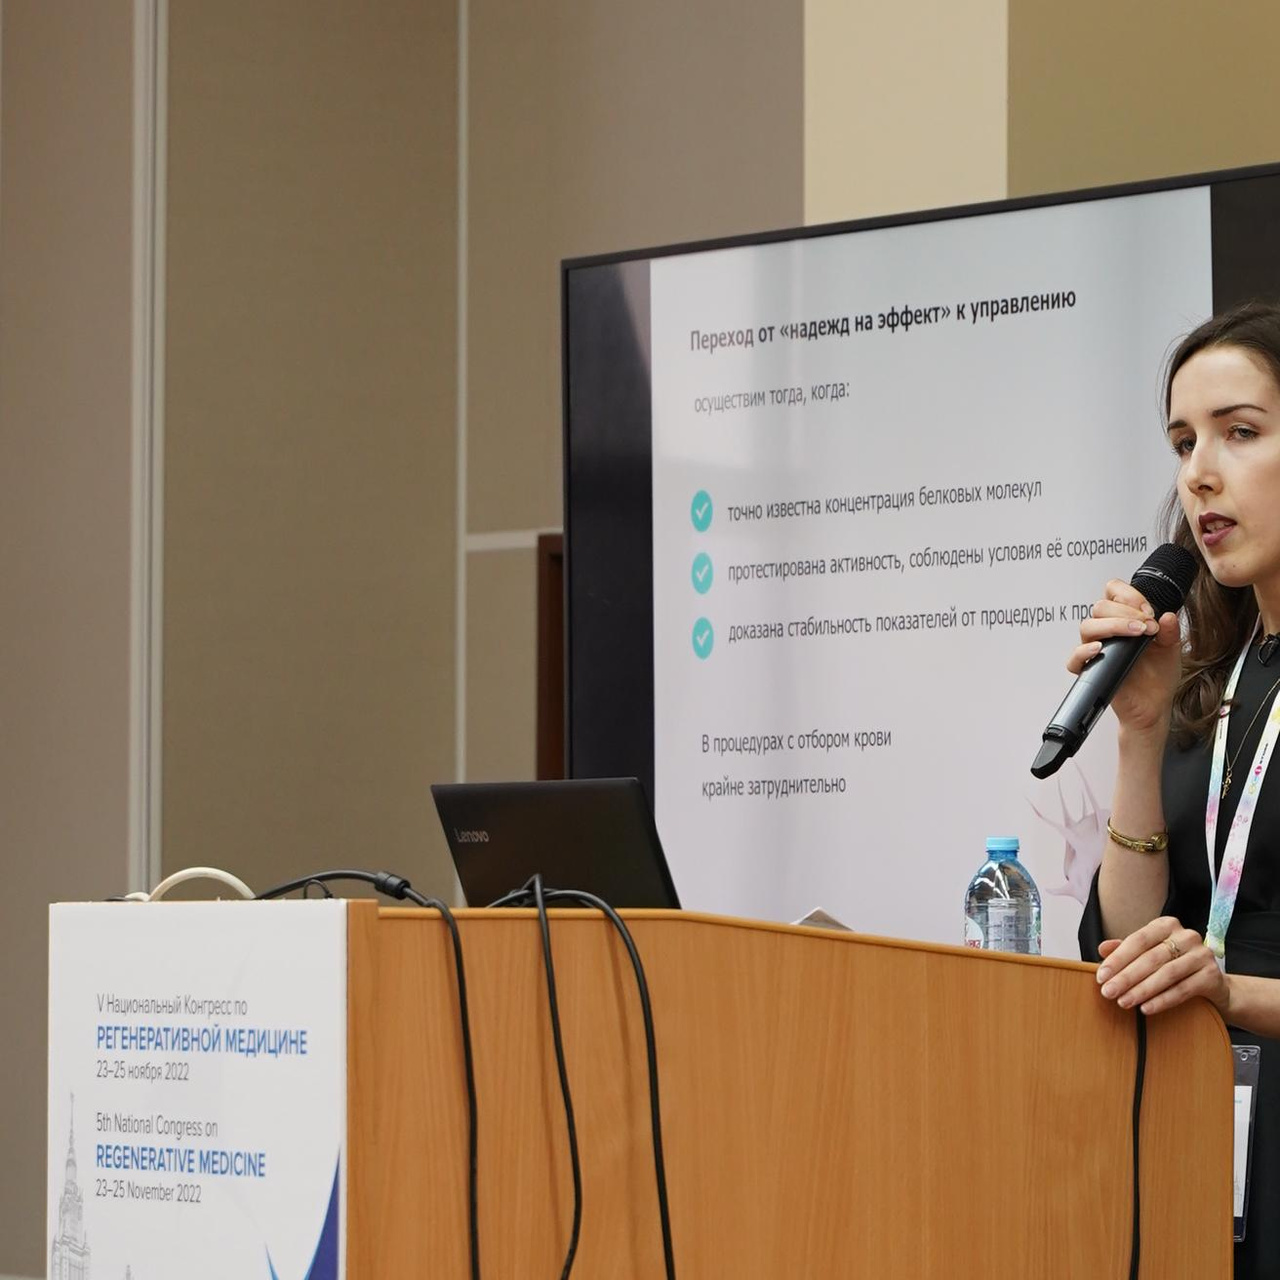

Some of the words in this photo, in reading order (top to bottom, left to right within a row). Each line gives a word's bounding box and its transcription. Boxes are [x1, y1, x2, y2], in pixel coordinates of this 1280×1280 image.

[690, 326, 755, 354] Переход
[757, 323, 776, 343] от
[779, 316, 851, 342] «надежд
[854, 313, 874, 332] на
[876, 304, 951, 332] эффект»
[955, 300, 967, 320] к
[970, 289, 1078, 324] управлению
[694, 387, 766, 416] осуществим
[769, 383, 808, 407] тогда,
[810, 379, 852, 402] когда:
[727, 503, 764, 522] точно
[766, 497, 822, 520] известна
[825, 490, 916, 516] концентрация
[918, 484, 983, 508] белковых
[986, 480, 1043, 504] молекул
[728, 558, 827, 586] протестирована
[829, 552, 906, 574] активность,
[909, 546, 985, 569] соблюдены
[988, 543, 1043, 568] условия
[1045, 537, 1063, 559] её
[1066, 534, 1149, 561] сохранения
[728, 622, 785, 645] доказана
[787, 615, 873, 642] стабильность
[875, 605, 958, 632] показателей
[961, 609, 977, 627] от
[980, 605, 1055, 630] процедуры
[1059, 605, 1068, 621] к
[1071, 603, 1094, 624] про
[701, 733, 711, 754] В
[713, 733, 785, 757] процедурах
[787, 733, 795, 750] с
[797, 728, 850, 753] отбором
[854, 729, 892, 751] крови
[701, 774, 745, 802] крайне
[747, 776, 847, 800] затруднительно
[96, 992, 105, 1013] V
[106, 993, 183, 1017] Национальный
[184, 994, 232, 1019] Конгресс
[233, 998, 249, 1017] по
[97, 1023, 222, 1053] РЕГЕНЕРАТИВНОЙ
[225, 1028, 308, 1058] МЕДИЦИНЕ
[128, 1061, 164, 1084] ноября
[164, 1061, 190, 1082] 2022
[96, 1111, 112, 1133] 5th
[114, 1112, 154, 1135] National
[156, 1114, 203, 1141] Congress
[204, 1120, 219, 1138] on
[96, 1143, 196, 1174] REGENERATIVE
[199, 1148, 267, 1178] MEDICINE
[127, 1180, 175, 1203] November
[176, 1182, 203, 1204] 2022
